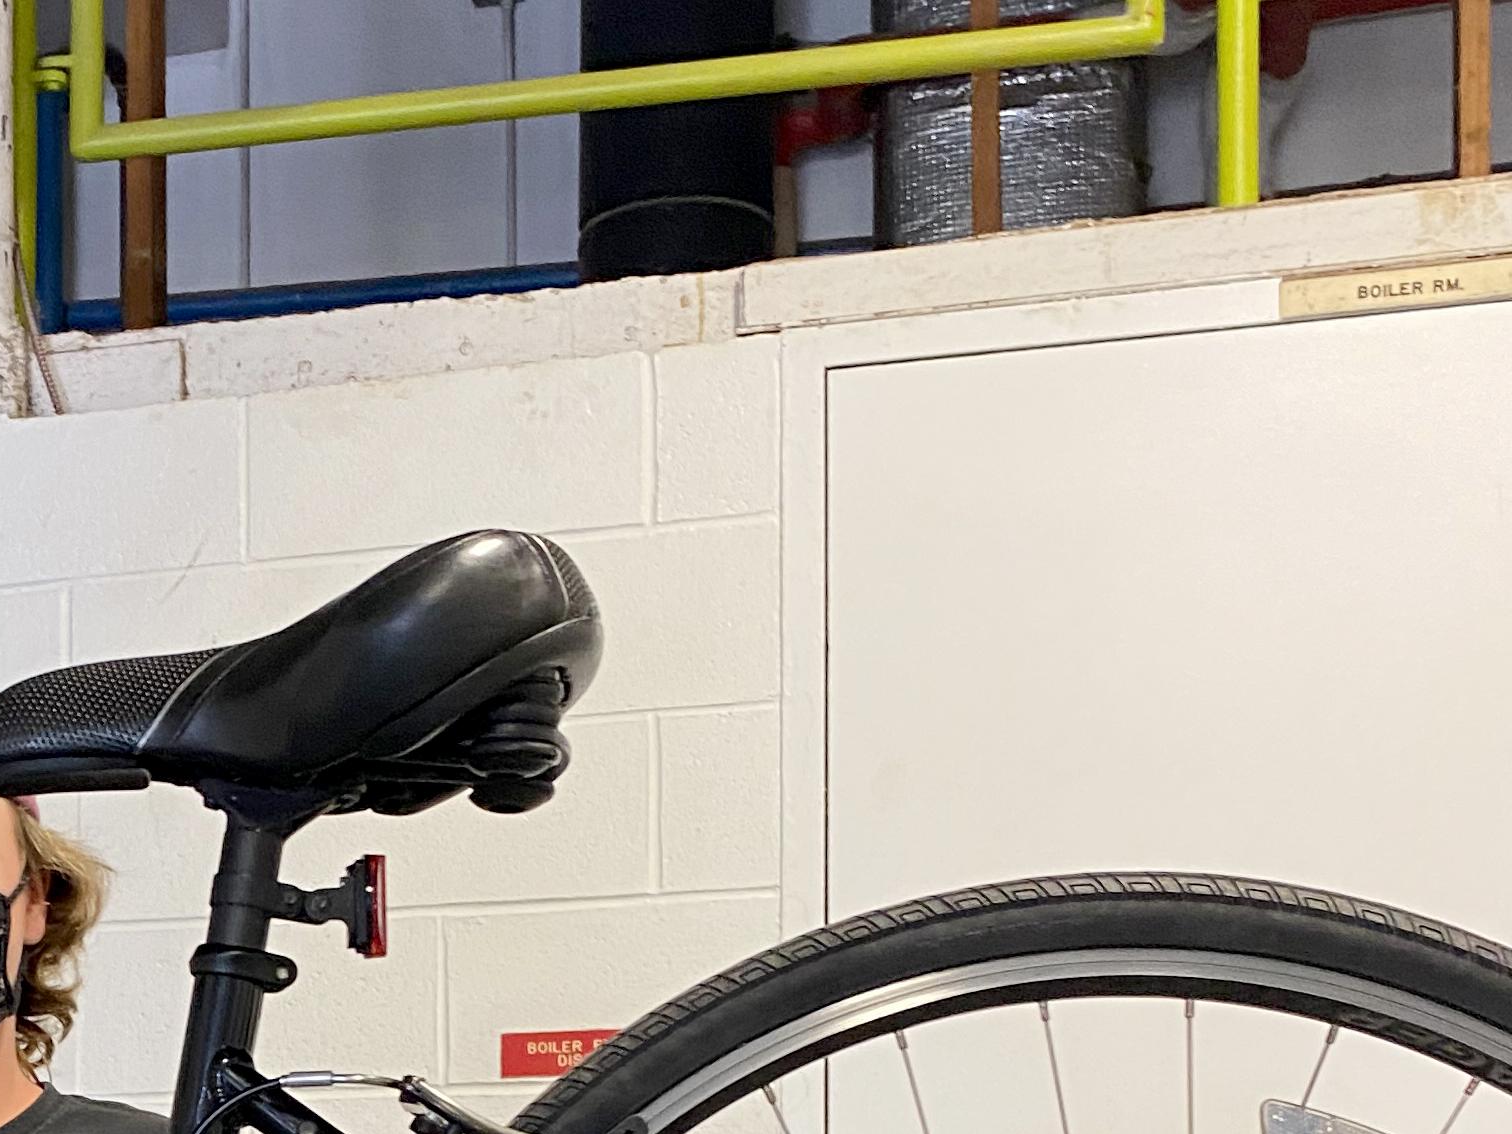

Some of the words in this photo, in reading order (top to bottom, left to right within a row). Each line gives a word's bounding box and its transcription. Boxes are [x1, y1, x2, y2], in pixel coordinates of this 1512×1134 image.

[1357, 281, 1424, 299] BOILER
[1432, 278, 1465, 294] RM.
[526, 1039, 583, 1055] BOILER
